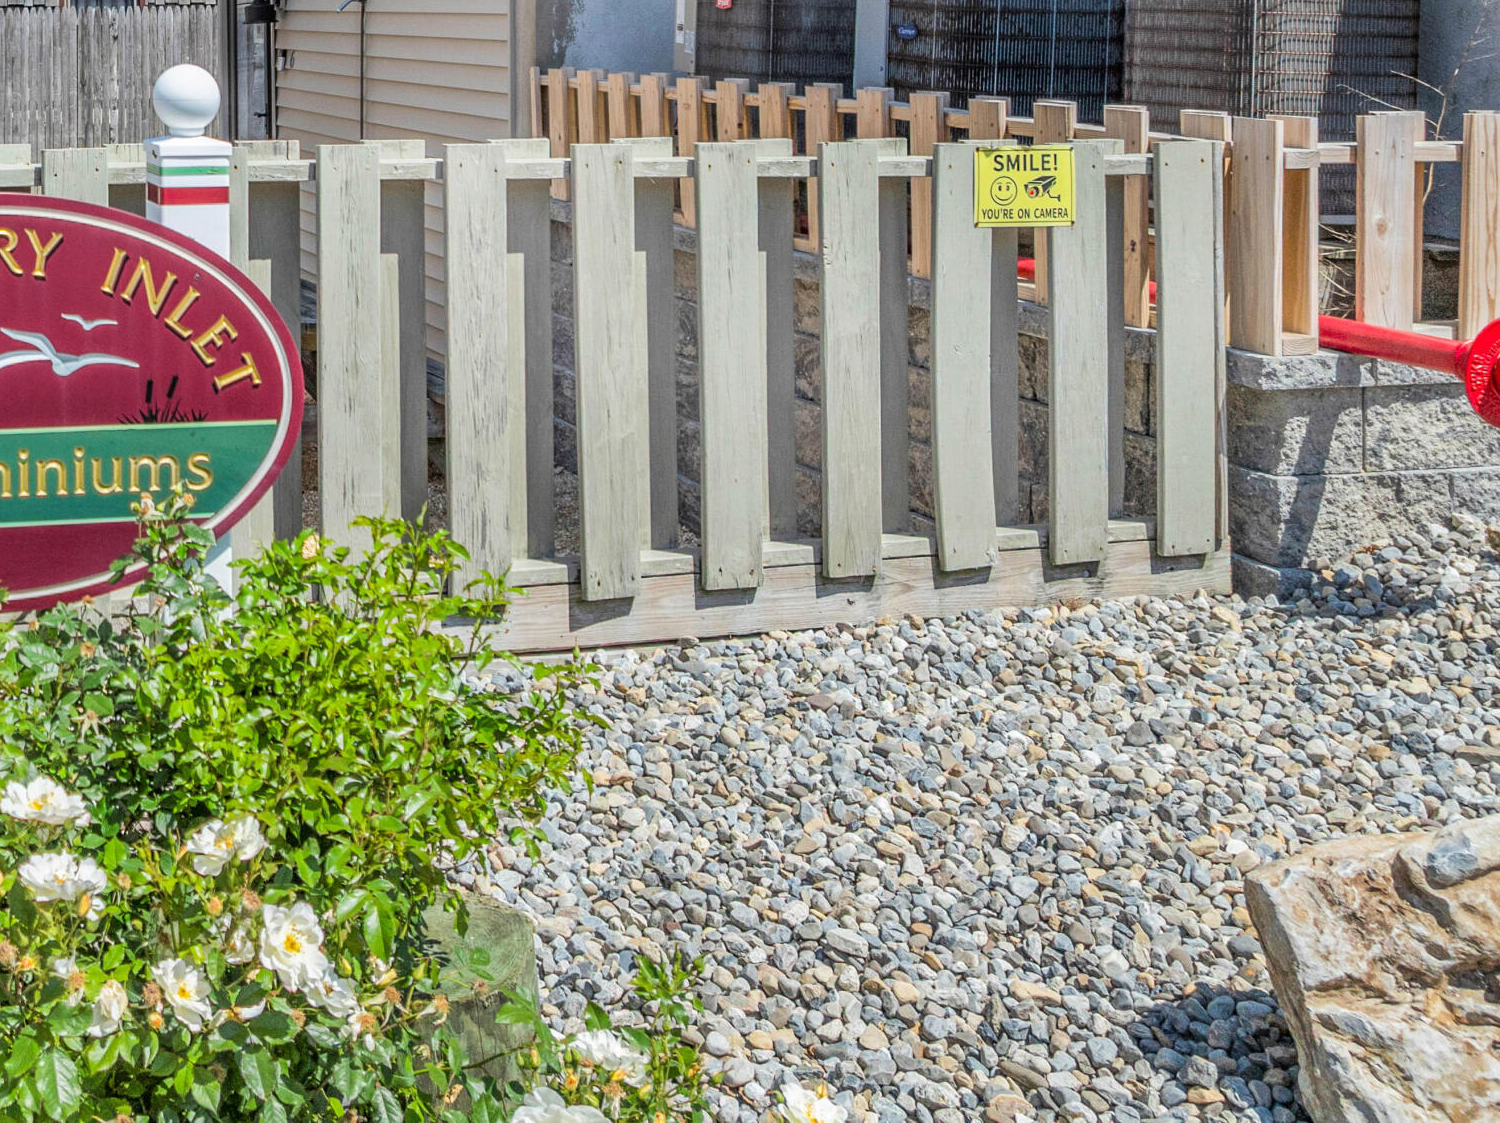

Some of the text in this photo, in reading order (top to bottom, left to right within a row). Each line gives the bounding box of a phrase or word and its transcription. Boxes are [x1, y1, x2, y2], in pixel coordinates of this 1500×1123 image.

[993, 153, 1058, 172] SMILE!
[981, 207, 1069, 220] YOU'RE ON CAMERA
[100, 247, 263, 394] INLET
